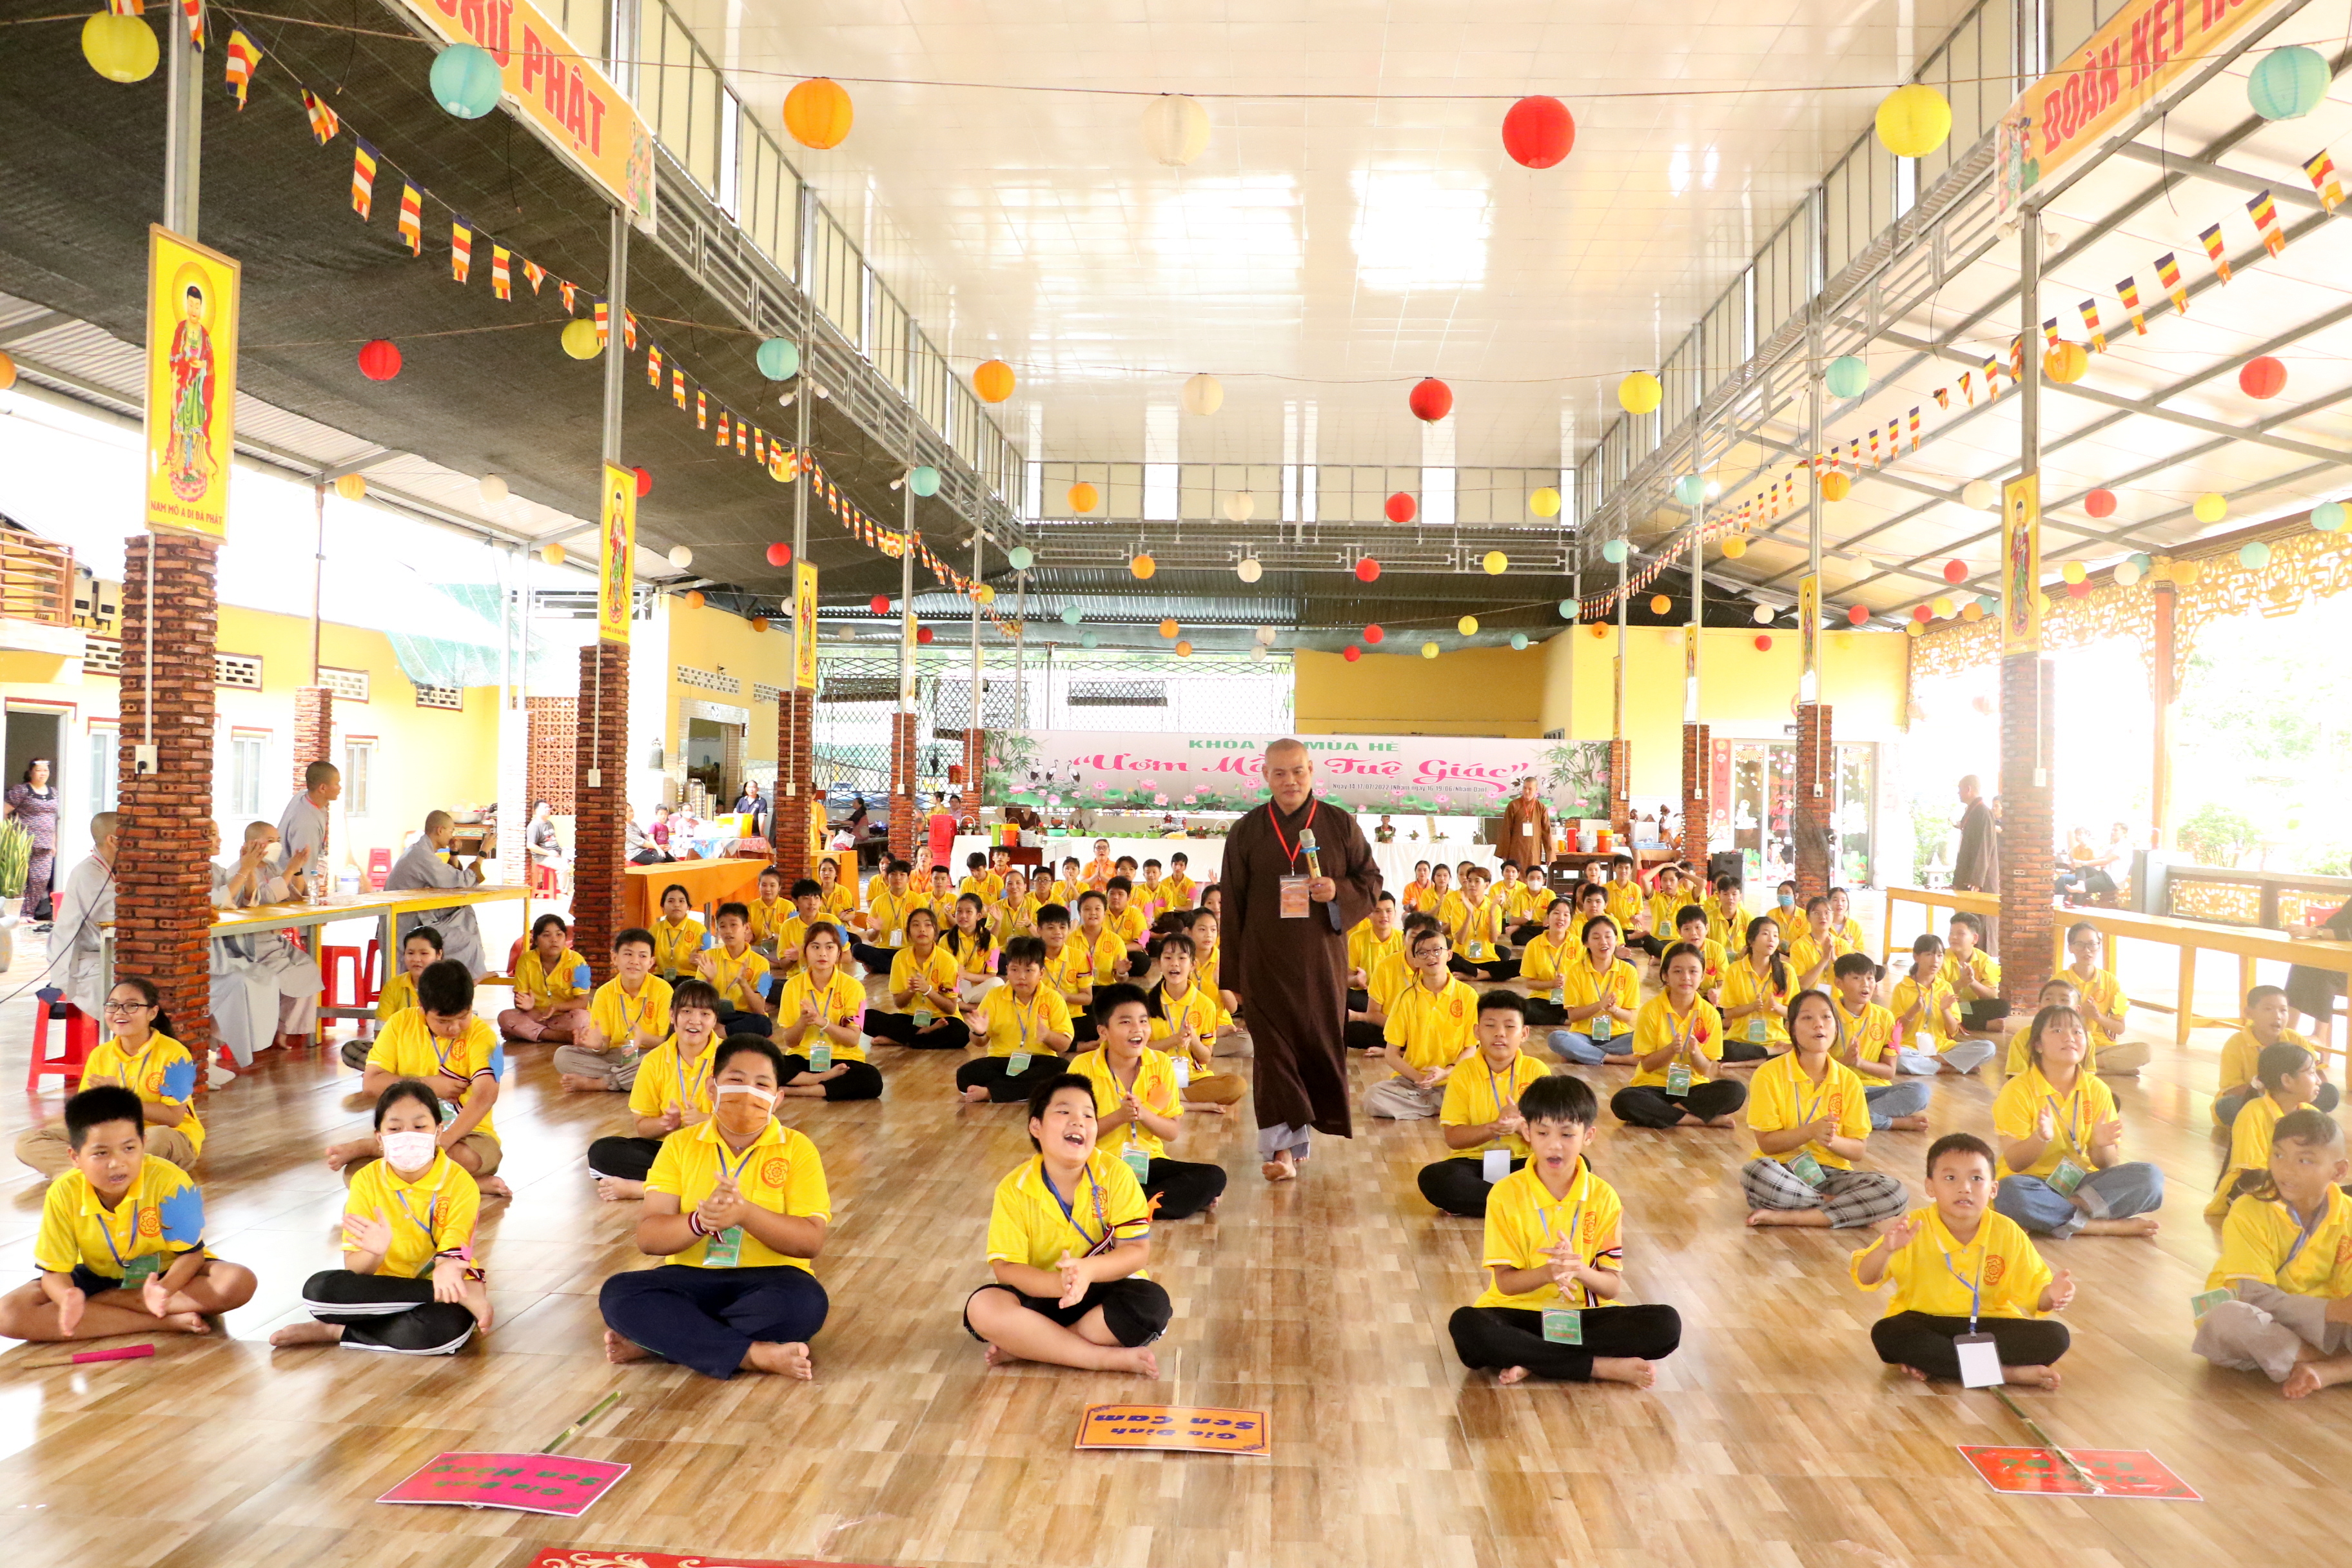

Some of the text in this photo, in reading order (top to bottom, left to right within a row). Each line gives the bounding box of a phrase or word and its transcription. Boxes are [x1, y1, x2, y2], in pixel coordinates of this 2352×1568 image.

[522, 23, 606, 159] PHẬT
[2042, 36, 2120, 156] ĐOÀN
[150, 500, 166, 513] NAM
[181, 507, 185, 517] A
[187, 509, 194, 519] DI
[206, 513, 222, 526] PHẬT
[1189, 739, 1255, 749] KHÓA
[1304, 740, 1359, 750] MÙA
[1369, 741, 1399, 752] HÈ
[1324, 758, 1404, 778] Tuệ
[1094, 1415, 1257, 1429] Sen Cam
[1186, 1430, 1237, 1439] Gia
[536, 1470, 603, 1485] Sen
